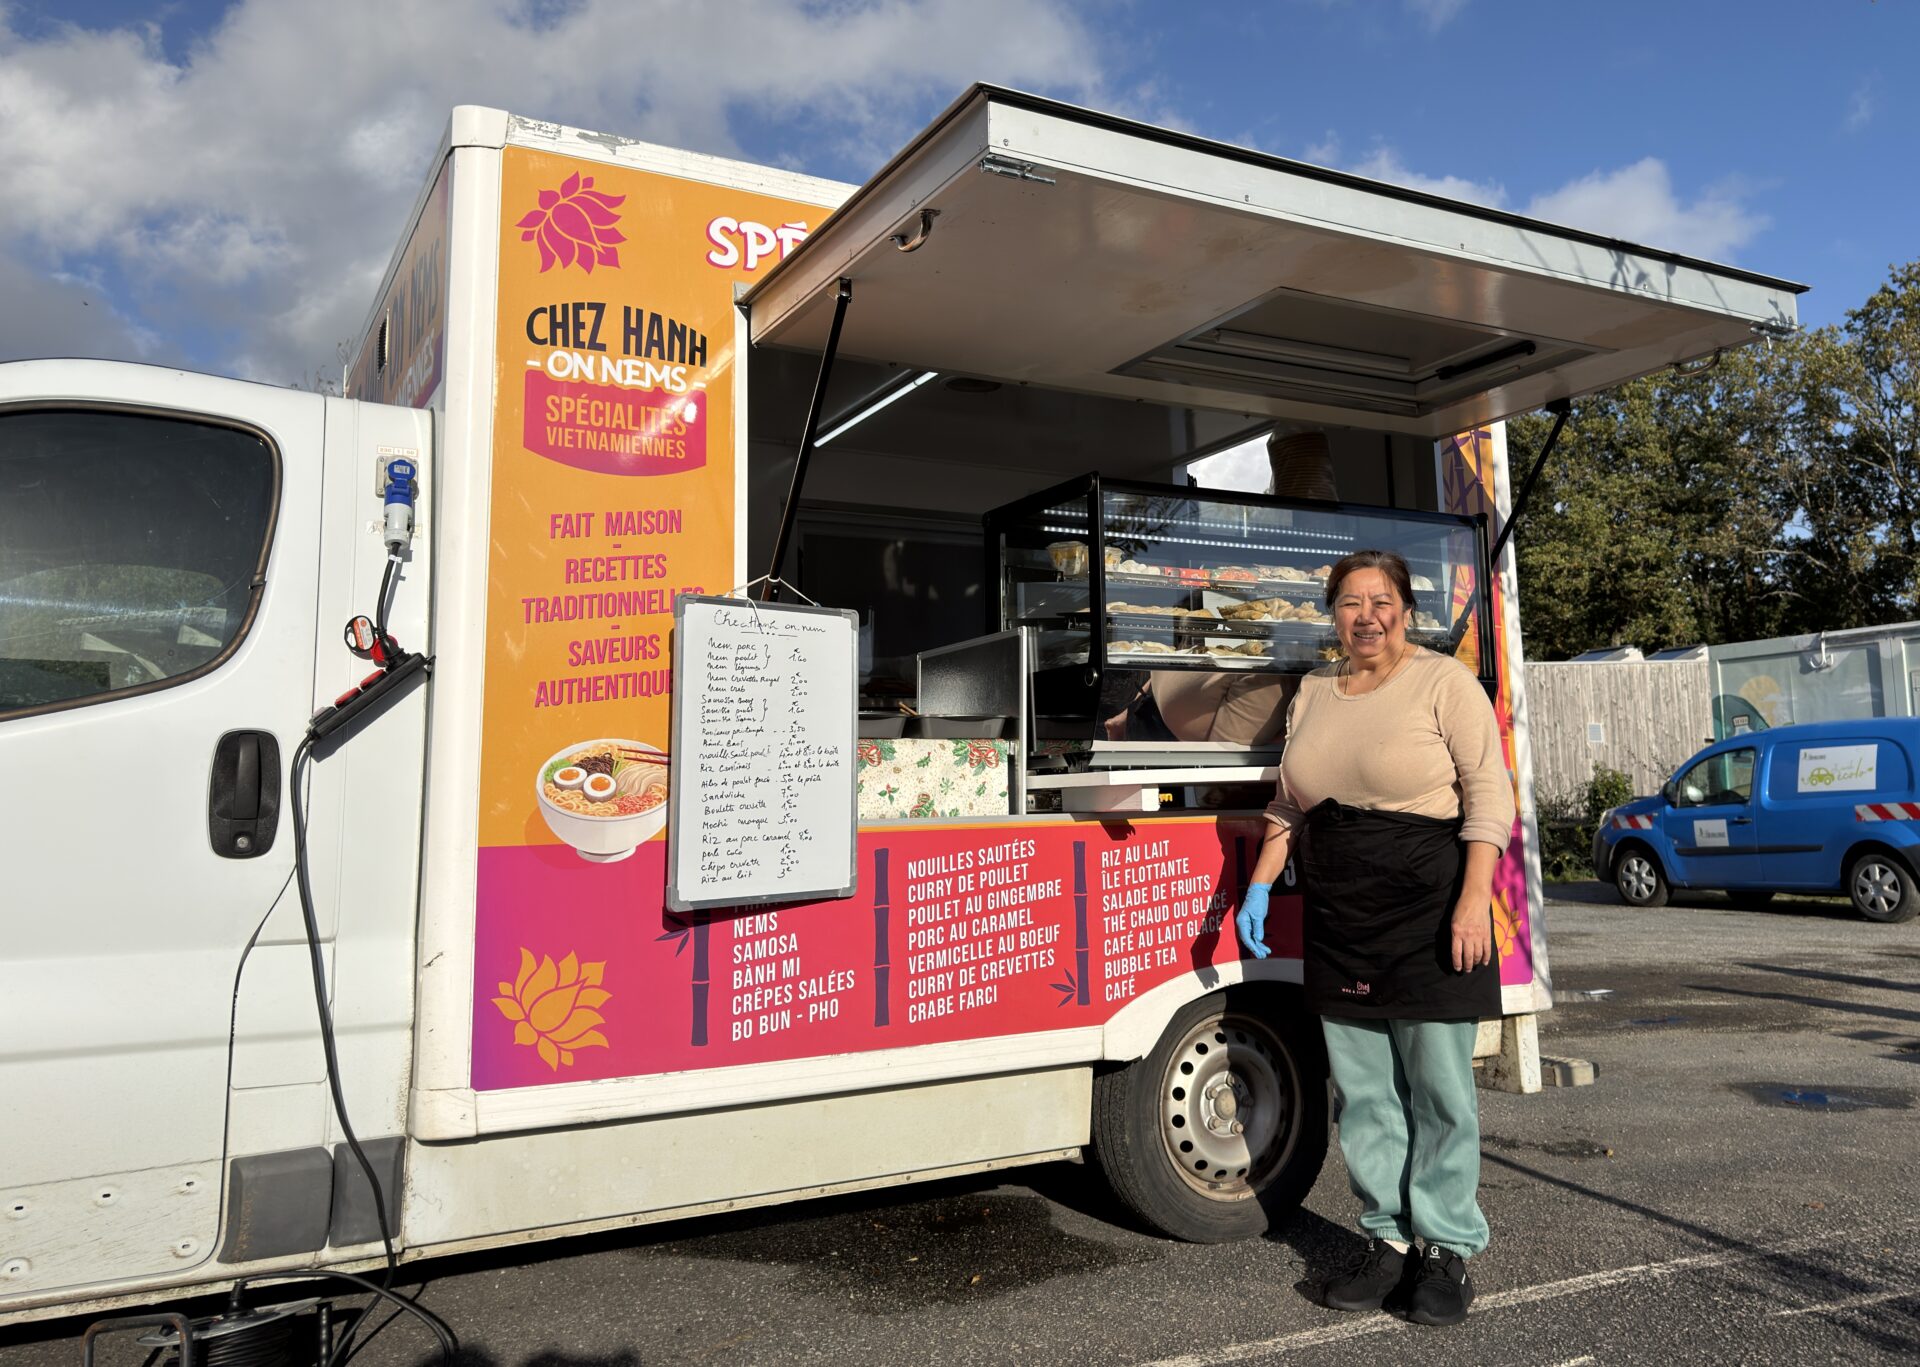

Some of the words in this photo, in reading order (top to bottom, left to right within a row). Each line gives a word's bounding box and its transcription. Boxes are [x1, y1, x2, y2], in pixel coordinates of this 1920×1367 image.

[526, 302, 606, 352] CHEZ
[622, 305, 707, 368] HANH
[547, 350, 595, 381] ON
[601, 355, 687, 392] NEMS
[546, 426, 686, 460] VIETNAMIENNES
[550, 512, 595, 539] FAIT
[605, 509, 682, 537] MAISON
[565, 553, 667, 584] RECETTES
[568, 634, 660, 667] SAVEURS
[908, 850, 974, 880] NOUILLES
[978, 838, 1036, 866] SAUTÉES
[1101, 849, 1121, 869] RIZ
[1124, 845, 1140, 864] AU
[1144, 839, 1170, 860] LAIT
[908, 877, 953, 903] CURRY
[958, 873, 975, 893] DE
[979, 863, 1029, 889] POULET
[1101, 870, 1121, 891] ÎLE
[1124, 857, 1190, 886] FLOTTANTE
[1102, 886, 1149, 913] SALADE
[1152, 883, 1167, 902] DE
[1171, 874, 1211, 899] FRUITS
[908, 899, 960, 928] POULET
[965, 895, 982, 916] AU
[987, 878, 1062, 911] GINGEMBRE
[1103, 910, 1127, 934] THÉ
[1130, 904, 1169, 929] CHAUD
[1173, 899, 1188, 919] OU
[1192, 889, 1228, 915] GLACÉ
[733, 912, 778, 939] NEMS
[908, 926, 945, 951] PORC
[949, 921, 967, 942] AU
[972, 908, 1034, 937] CARAMEL
[1104, 930, 1134, 957] CAFÉ
[1138, 929, 1153, 949] AU
[1157, 922, 1183, 945] LAIT
[1187, 914, 1223, 938] GLACÉ
[733, 932, 799, 964] SAMOSA
[908, 939, 993, 975] VERMICELLE
[997, 934, 1015, 955] AU
[1020, 924, 1061, 950] BOEUF
[1105, 952, 1151, 980] BUBBLE
[1155, 946, 1178, 967] TEA
[732, 987, 793, 1016] CRÊPES
[798, 969, 855, 1000] SALÉES
[733, 964, 776, 990] BÀNH
[782, 956, 800, 979] MI
[908, 971, 954, 999] CURRY
[959, 966, 976, 987] DE
[981, 948, 1055, 982] CREVETTES
[1105, 975, 1136, 1002] CAFÉ
[732, 1018, 753, 1042] BO
[759, 1009, 791, 1035] BUN
[809, 998, 839, 1023] PHO
[908, 995, 954, 1024] CRABE
[959, 984, 998, 1011] FARCI
[1430, 1245, 1440, 1256] G
